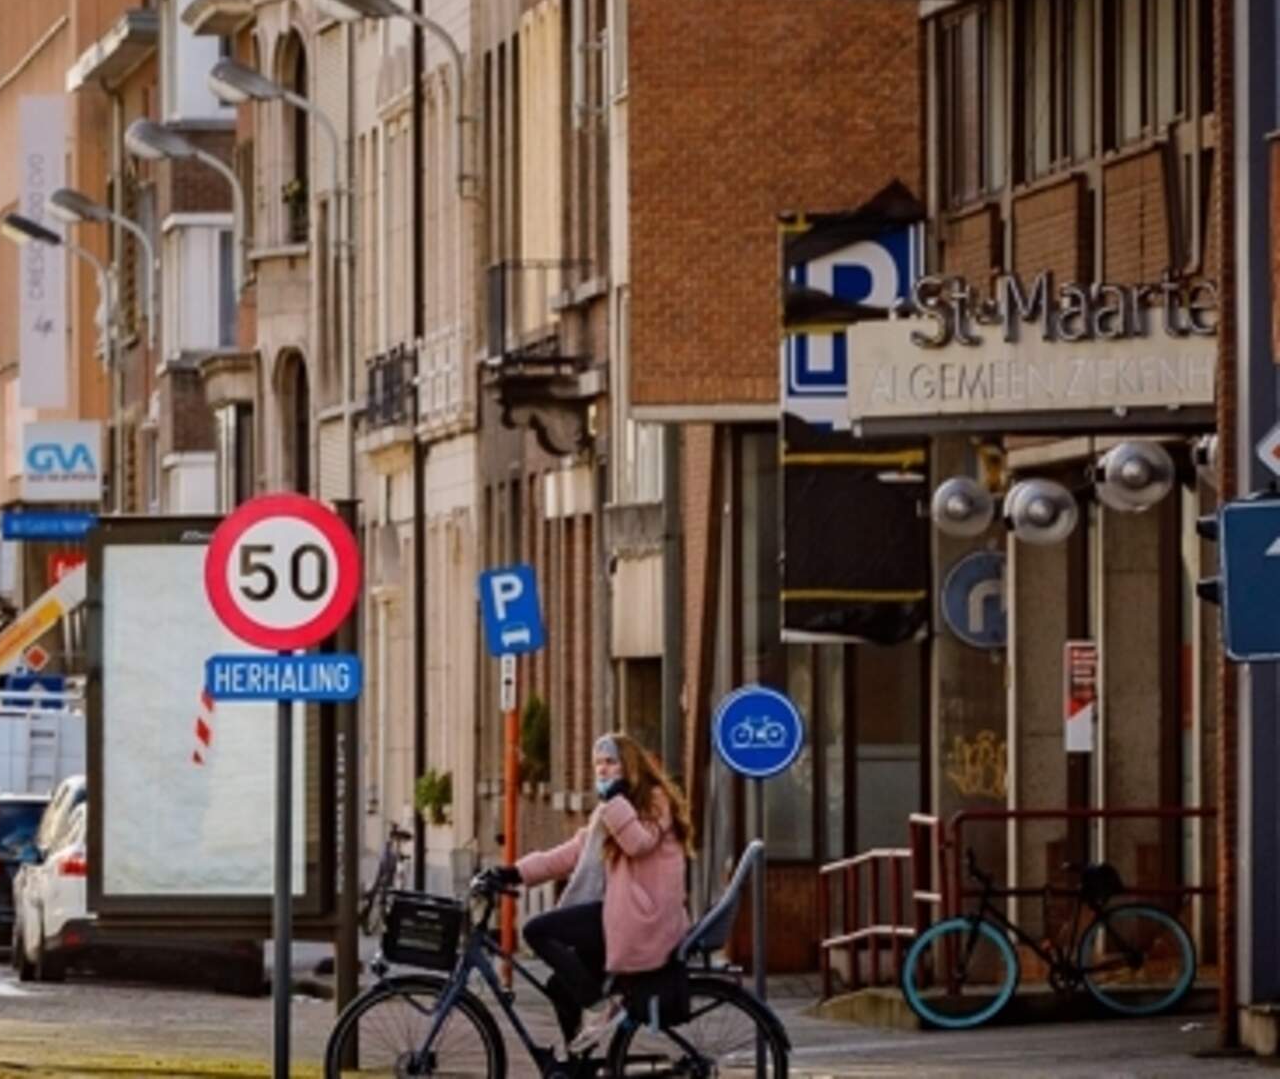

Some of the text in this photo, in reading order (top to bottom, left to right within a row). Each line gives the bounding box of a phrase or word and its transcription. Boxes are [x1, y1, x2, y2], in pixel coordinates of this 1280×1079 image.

[870, 358, 1056, 404] ALGEMEEN
[27, 443, 97, 473] GVA
[238, 543, 328, 602] 50
[491, 574, 523, 620] P
[213, 662, 351, 694] HERHALING
